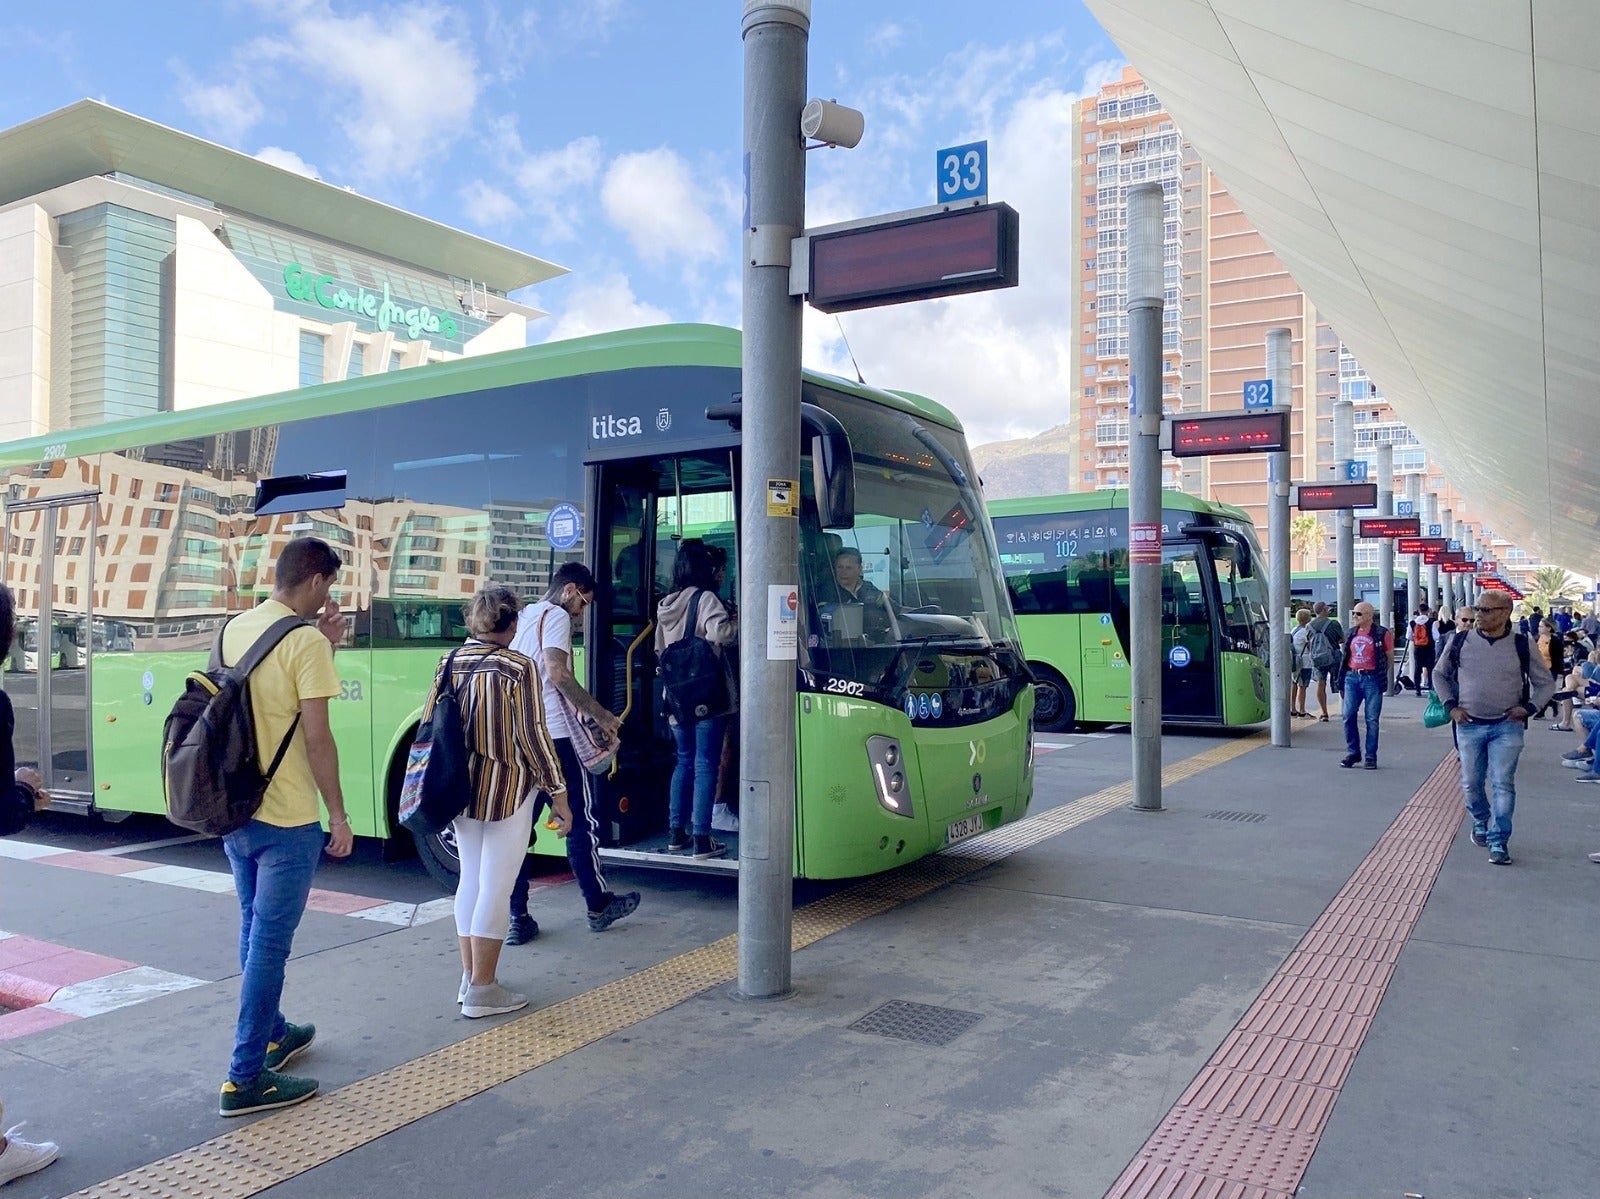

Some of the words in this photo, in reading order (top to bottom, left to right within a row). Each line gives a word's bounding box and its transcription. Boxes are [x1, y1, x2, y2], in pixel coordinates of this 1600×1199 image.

[942, 150, 981, 195] 33
[283, 262, 315, 301] El
[314, 274, 377, 318] Corte
[1247, 383, 1270, 405] 32
[592, 414, 642, 439] titsa
[43, 443, 67, 460] 2902
[1350, 463, 1365, 478] 31
[1399, 502, 1412, 514] 30
[1430, 525, 1441, 535] 29
[1056, 540, 1078, 558] 102
[827, 677, 864, 696] 2902
